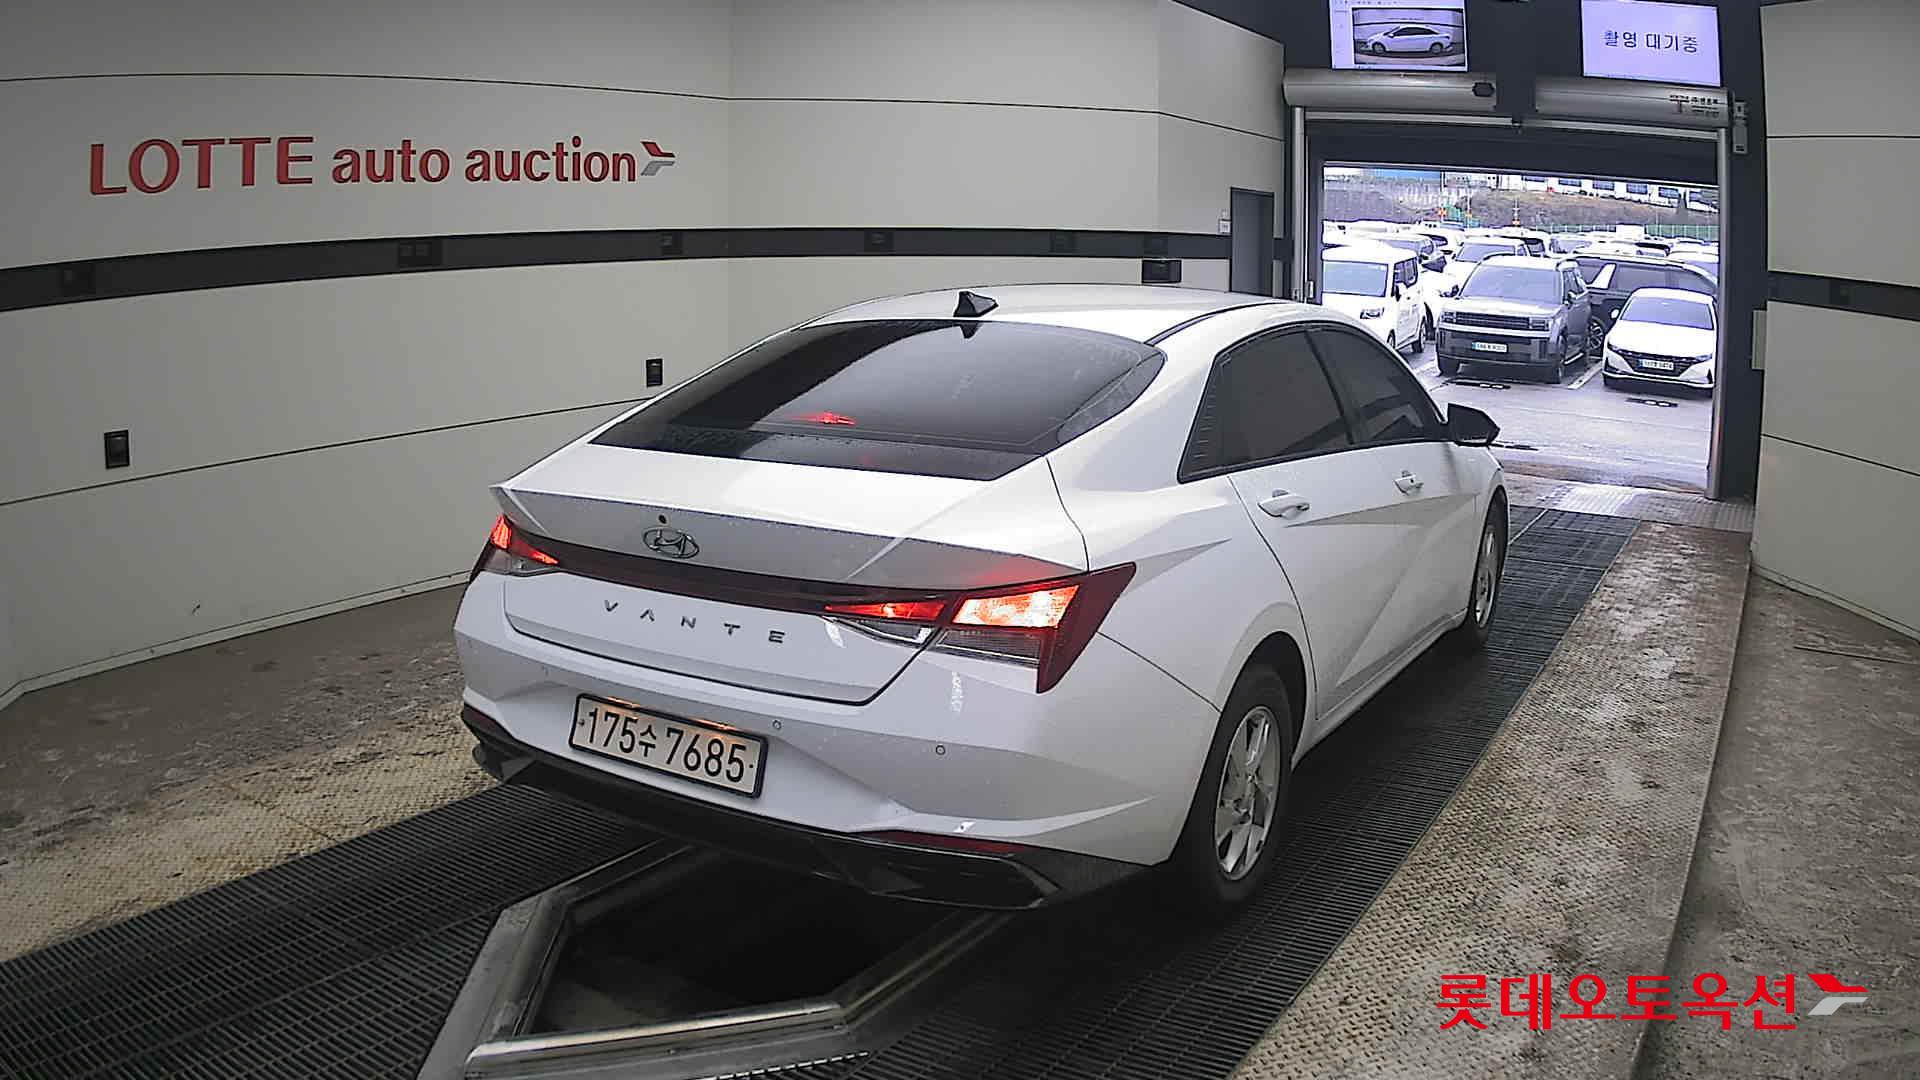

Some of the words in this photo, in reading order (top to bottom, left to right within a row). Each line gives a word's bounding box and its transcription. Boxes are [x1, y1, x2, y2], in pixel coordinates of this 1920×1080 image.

[1604, 30, 1637, 48] 촬영
[1646, 33, 1698, 53] 대기중
[90, 136, 314, 195] LOTTE
[332, 138, 450, 184] auto
[464, 135, 637, 183] auction
[665, 727, 747, 783] 7685
